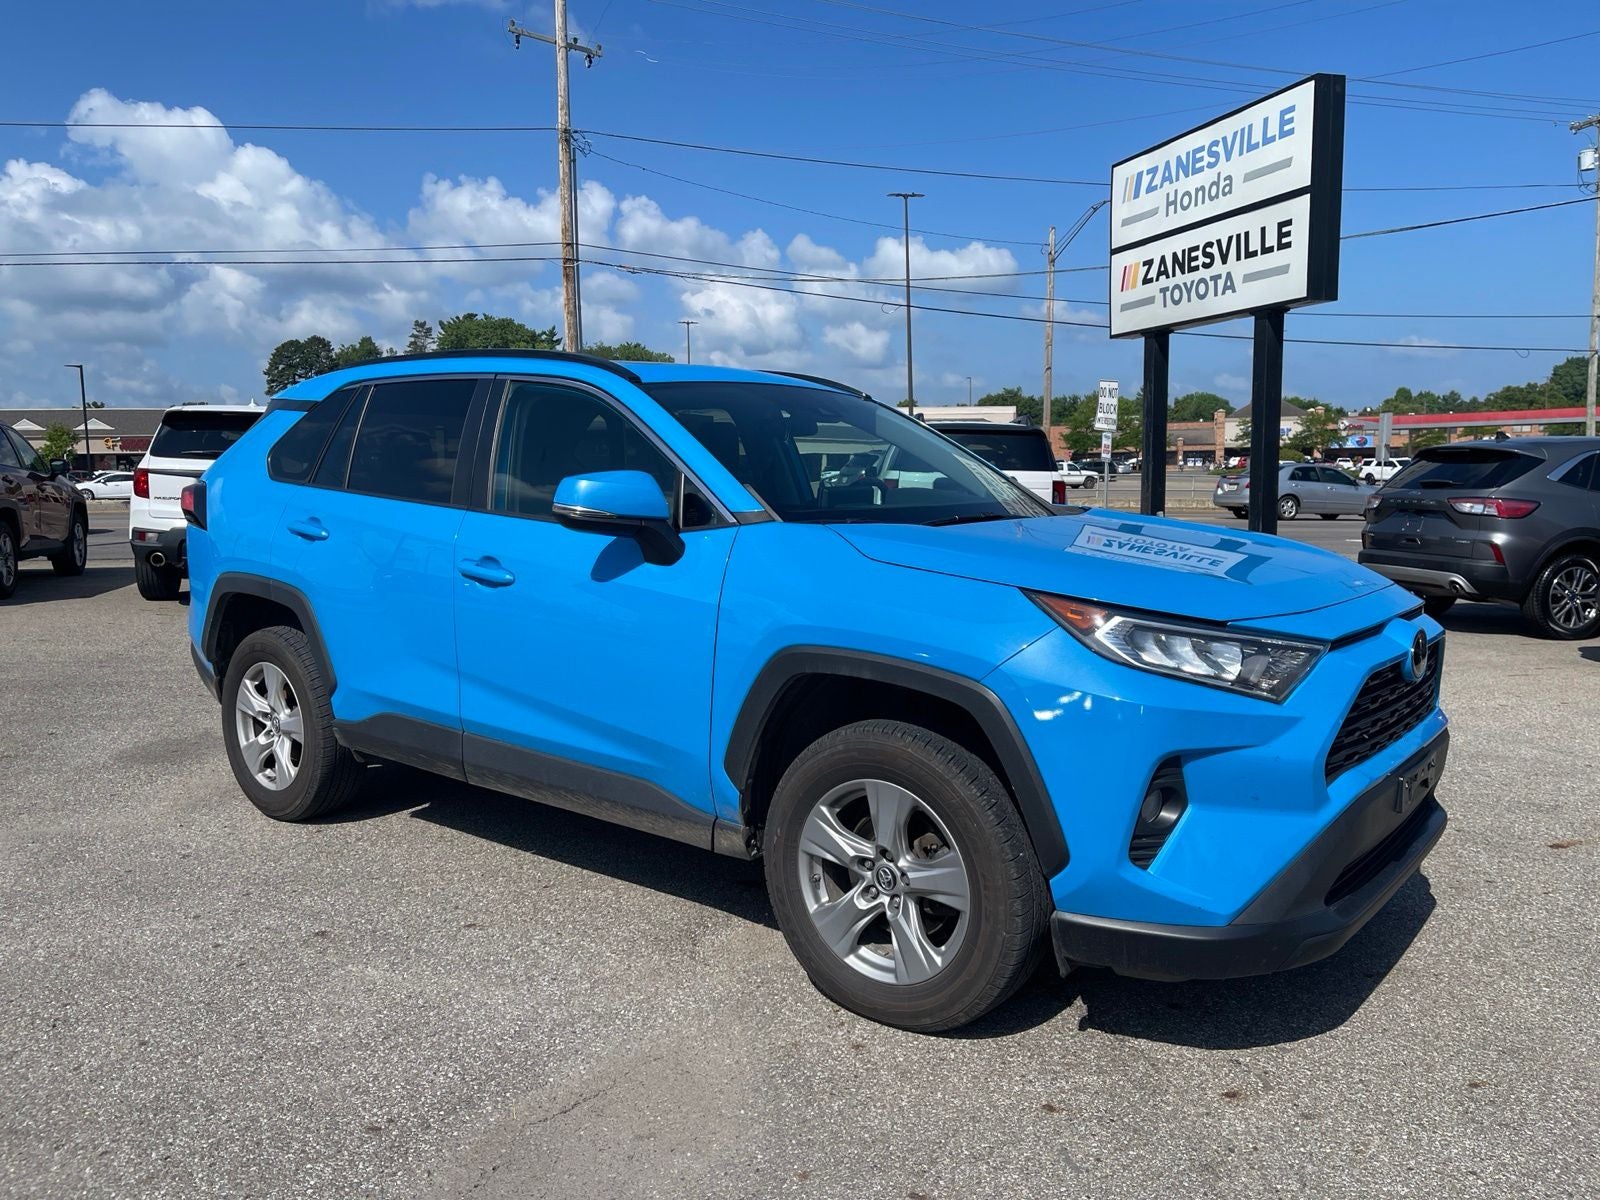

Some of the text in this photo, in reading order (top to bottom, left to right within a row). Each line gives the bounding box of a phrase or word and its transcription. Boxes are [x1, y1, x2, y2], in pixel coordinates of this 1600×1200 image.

[1145, 104, 1296, 195] ZANESVILLE
[1165, 172, 1234, 217] Honda
[1141, 218, 1293, 286] ZANESVILLE
[1159, 271, 1237, 308] TOYOTA
[1099, 403, 1117, 414] BLOCK
[1100, 387, 1118, 399] DO NOT
